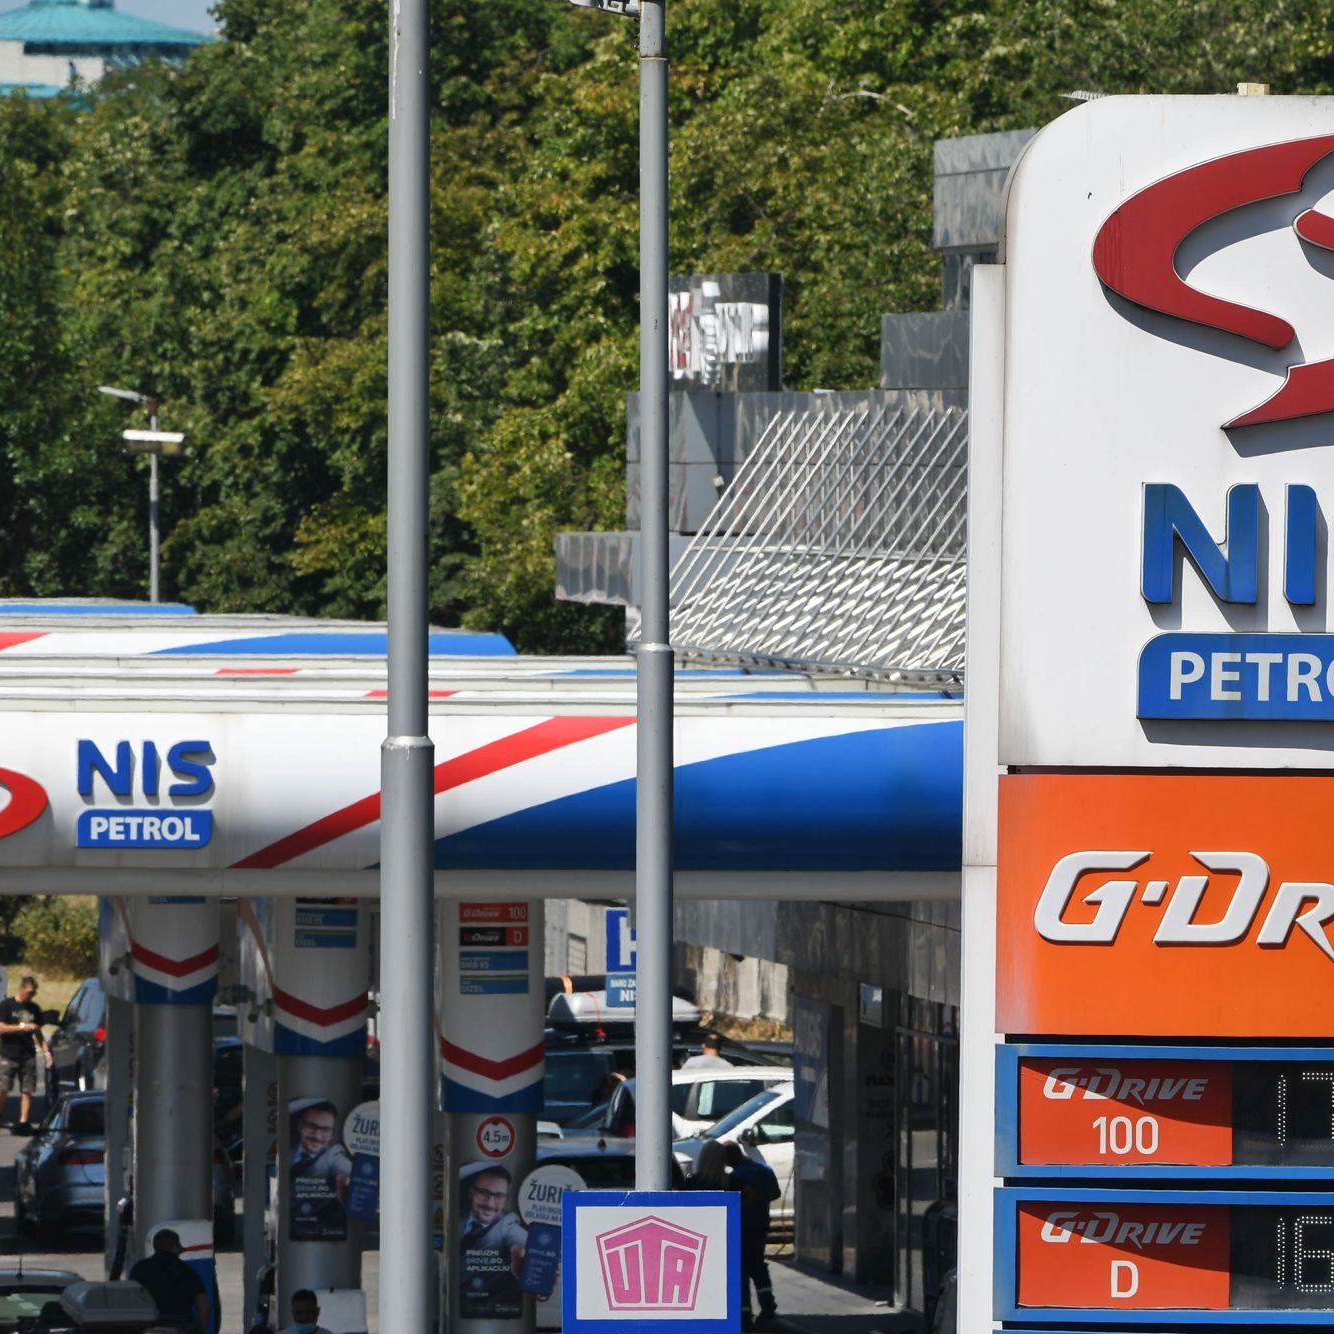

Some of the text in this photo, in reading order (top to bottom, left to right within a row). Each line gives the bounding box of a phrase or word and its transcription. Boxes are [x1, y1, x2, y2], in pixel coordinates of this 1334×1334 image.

[77, 739, 214, 796] NIS
[90, 816, 200, 841] PETROL
[620, 989, 636, 1002] NI
[352, 1113, 380, 1137] ŽUR
[1092, 1116, 1159, 1155] 100
[527, 1179, 572, 1204] ŽURI
[604, 1222, 699, 1304] UTA
[1110, 1260, 1139, 1298] D
